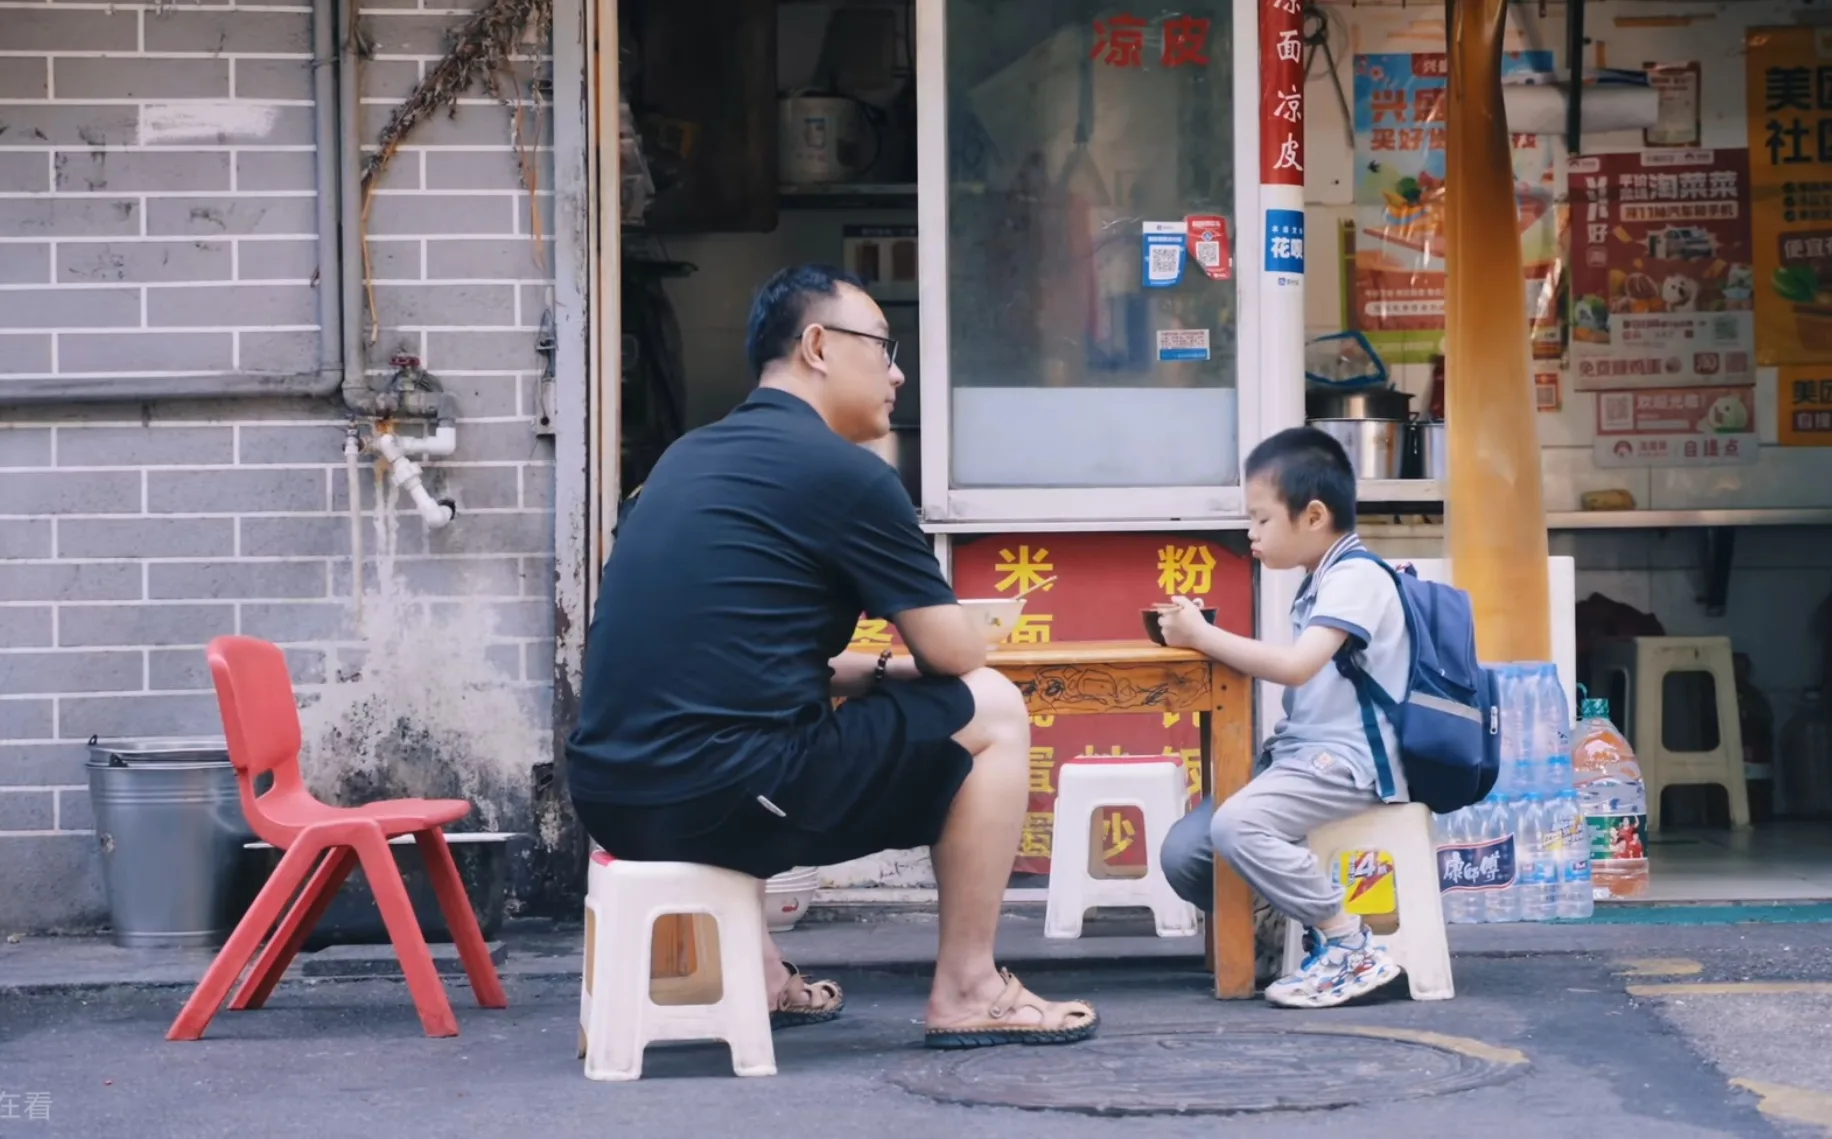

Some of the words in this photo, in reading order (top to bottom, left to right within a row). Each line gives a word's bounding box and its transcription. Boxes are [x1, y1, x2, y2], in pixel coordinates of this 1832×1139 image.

[1090, 11, 1211, 68] 凉皮
[1765, 66, 1832, 112] 美
[1765, 117, 1832, 165] 社
[994, 544, 1217, 595] 米粉
